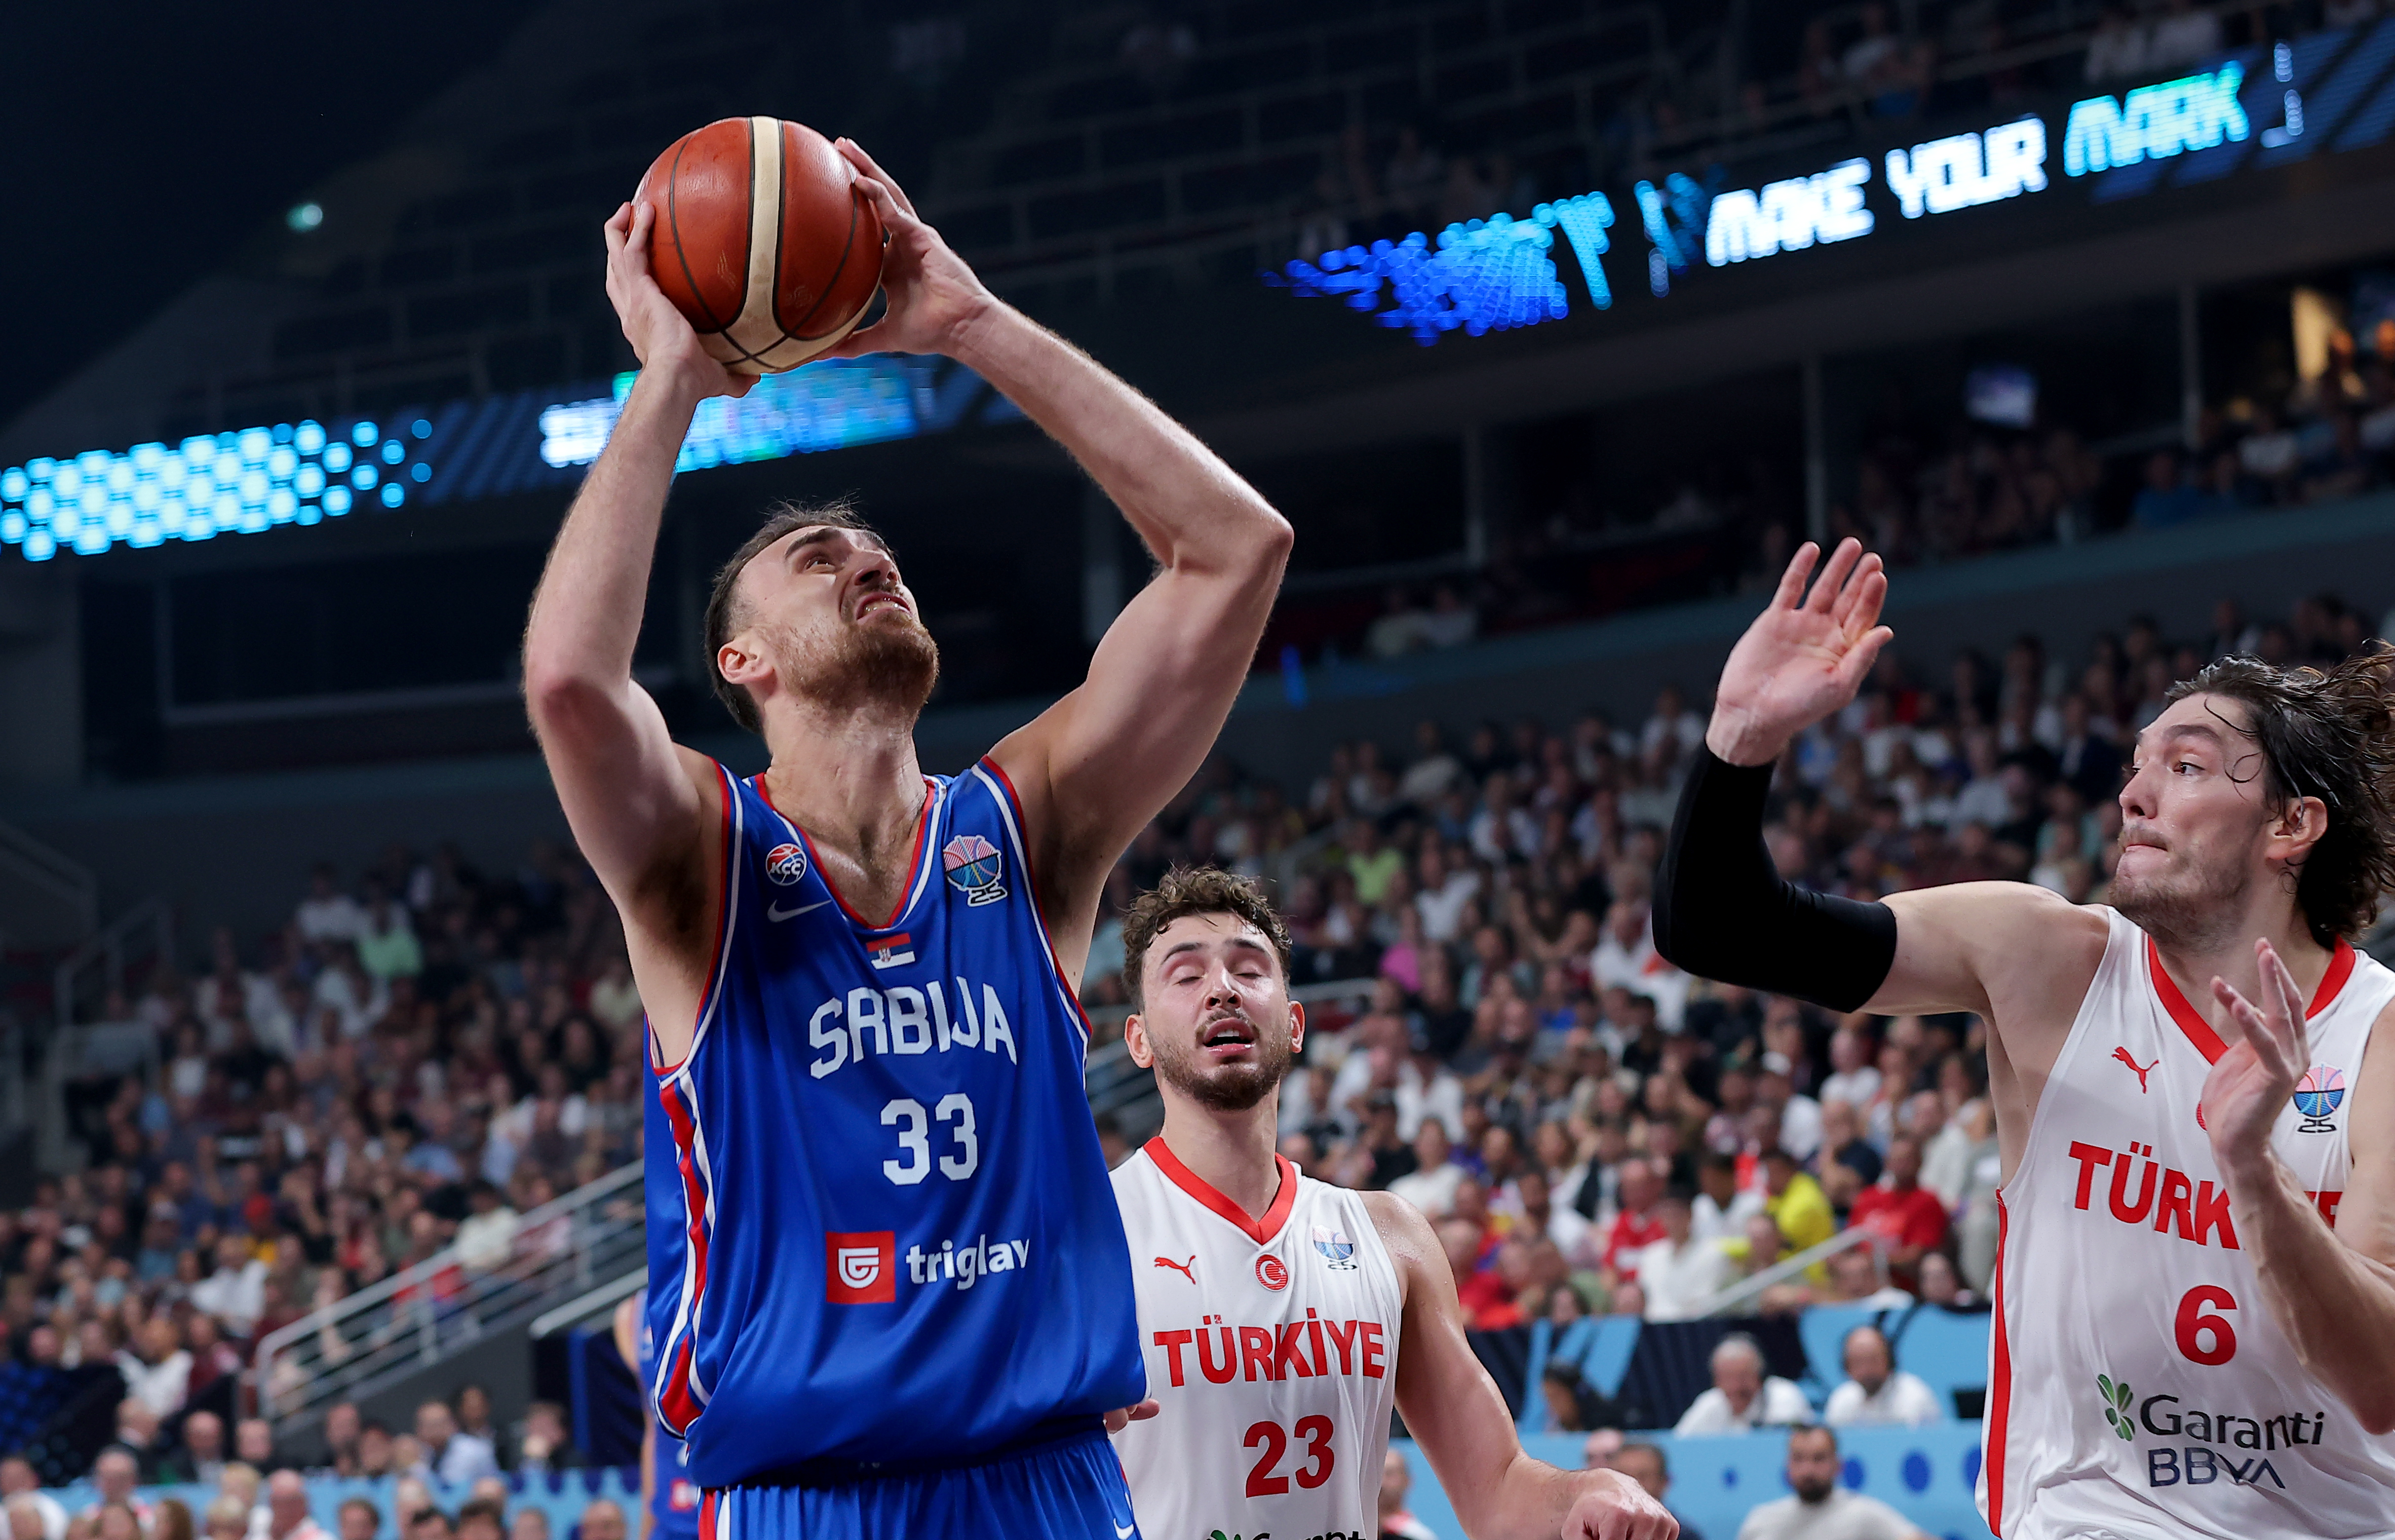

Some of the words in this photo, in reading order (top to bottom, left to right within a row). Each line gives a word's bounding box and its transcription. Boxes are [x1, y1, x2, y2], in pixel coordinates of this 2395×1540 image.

[1706, 157, 1875, 266] MAKE
[1885, 112, 2048, 219] YOUR
[2063, 60, 2249, 177] MARK
[809, 976, 1017, 1080] SRBIJA
[880, 1093, 978, 1186] 33
[2069, 1140, 2344, 1250] TÜRK
[905, 1234, 1030, 1290] triglav
[1153, 1307, 1385, 1388] TÜRKİYE
[2174, 1284, 2237, 1366] 6
[1243, 1414, 1335, 1498] 23
[2140, 1394, 2325, 1450] Garanti
[2148, 1447, 2286, 1489] BBVA
